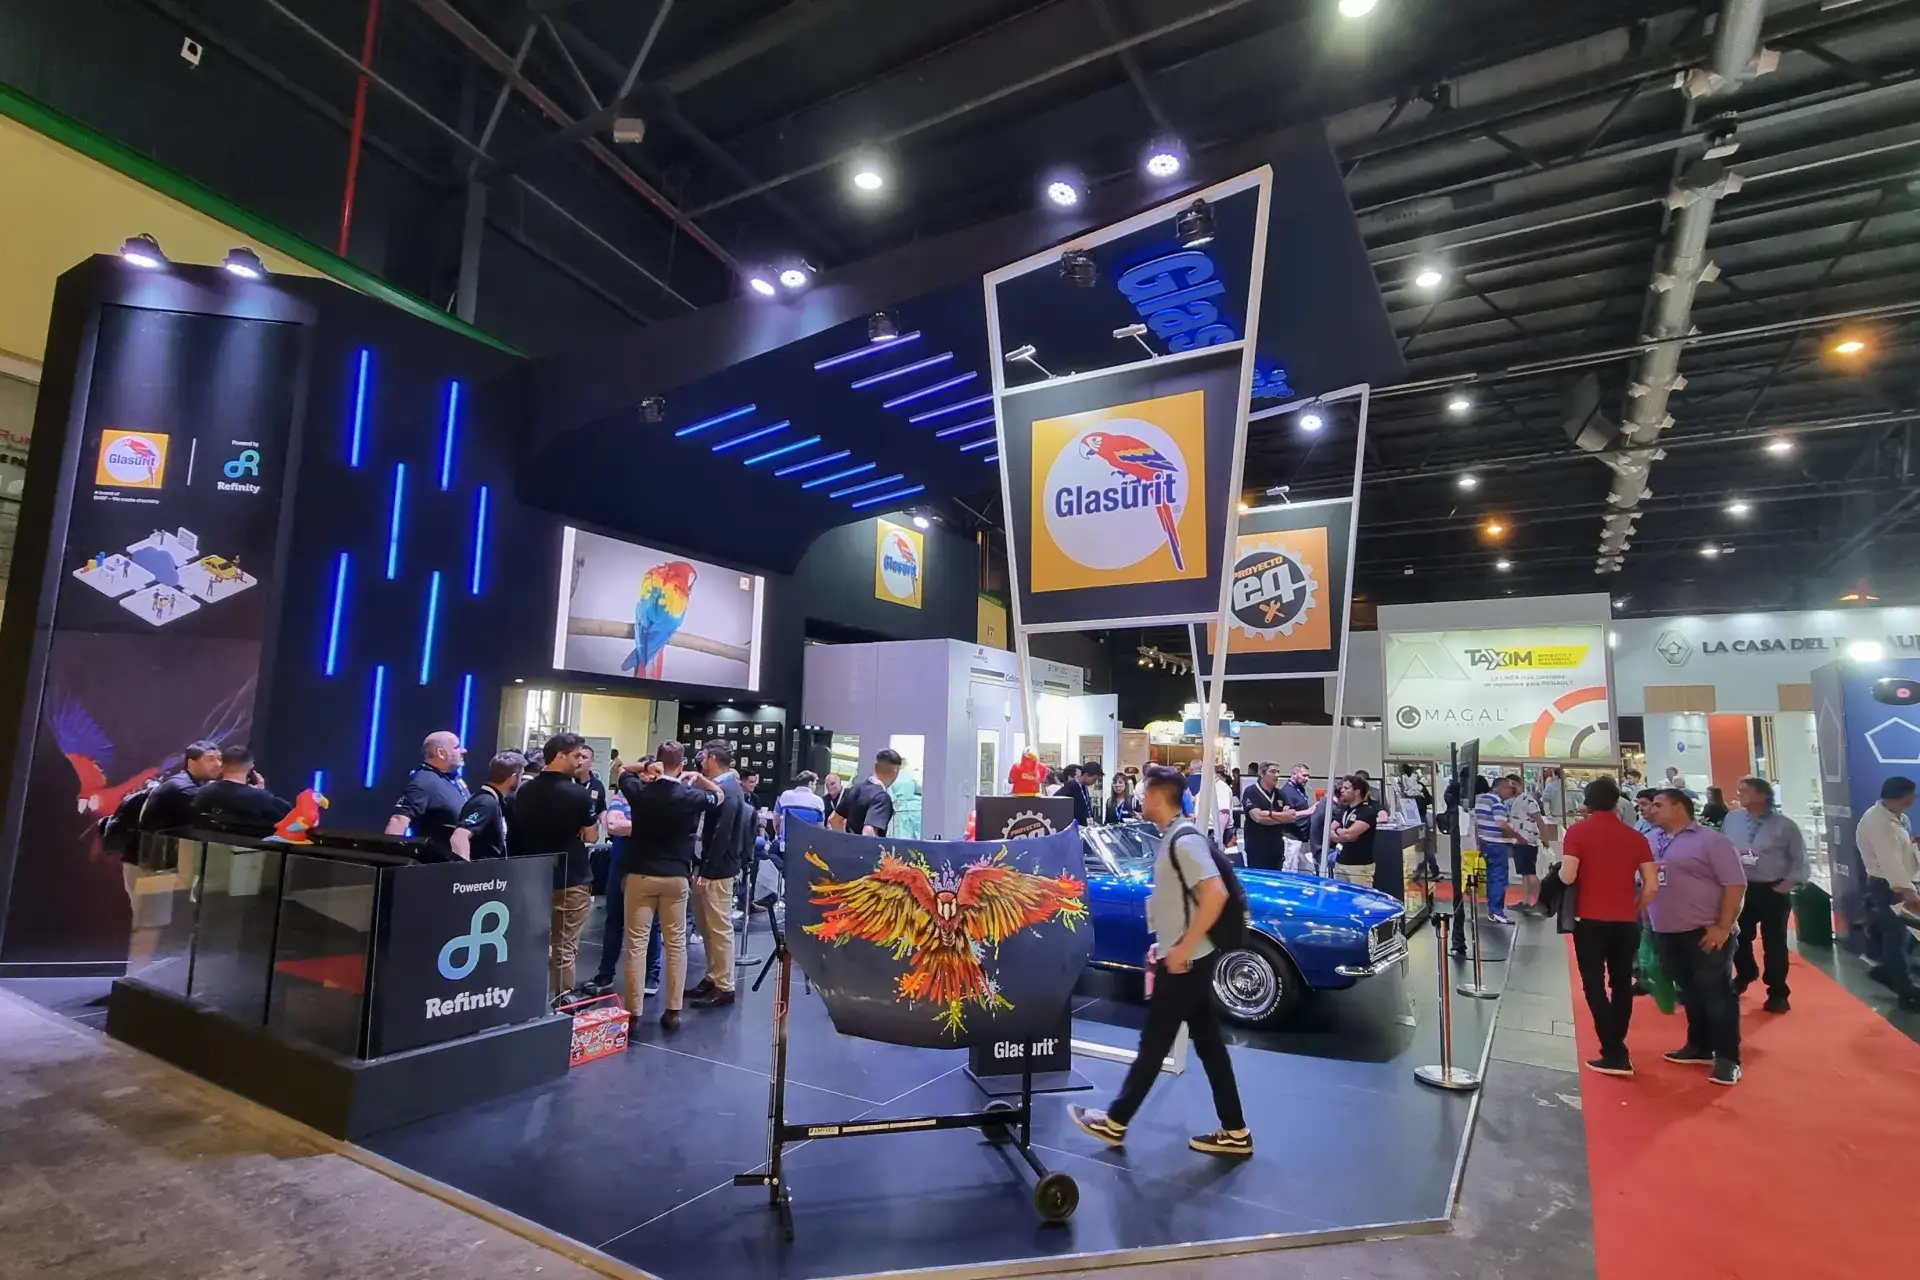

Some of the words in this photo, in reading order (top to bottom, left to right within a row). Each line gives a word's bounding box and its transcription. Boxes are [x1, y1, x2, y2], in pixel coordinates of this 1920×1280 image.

[217, 481, 260, 494] Refinity
[1702, 640, 1729, 654] LA
[1732, 638, 1786, 653] CASA
[1790, 637, 1829, 650] DEL
[1464, 649, 1533, 671] TAXIM
[1425, 708, 1506, 721] MAGAL
[453, 880, 494, 894] Powered
[496, 879, 508, 892] by
[425, 987, 514, 1019] Refinity
